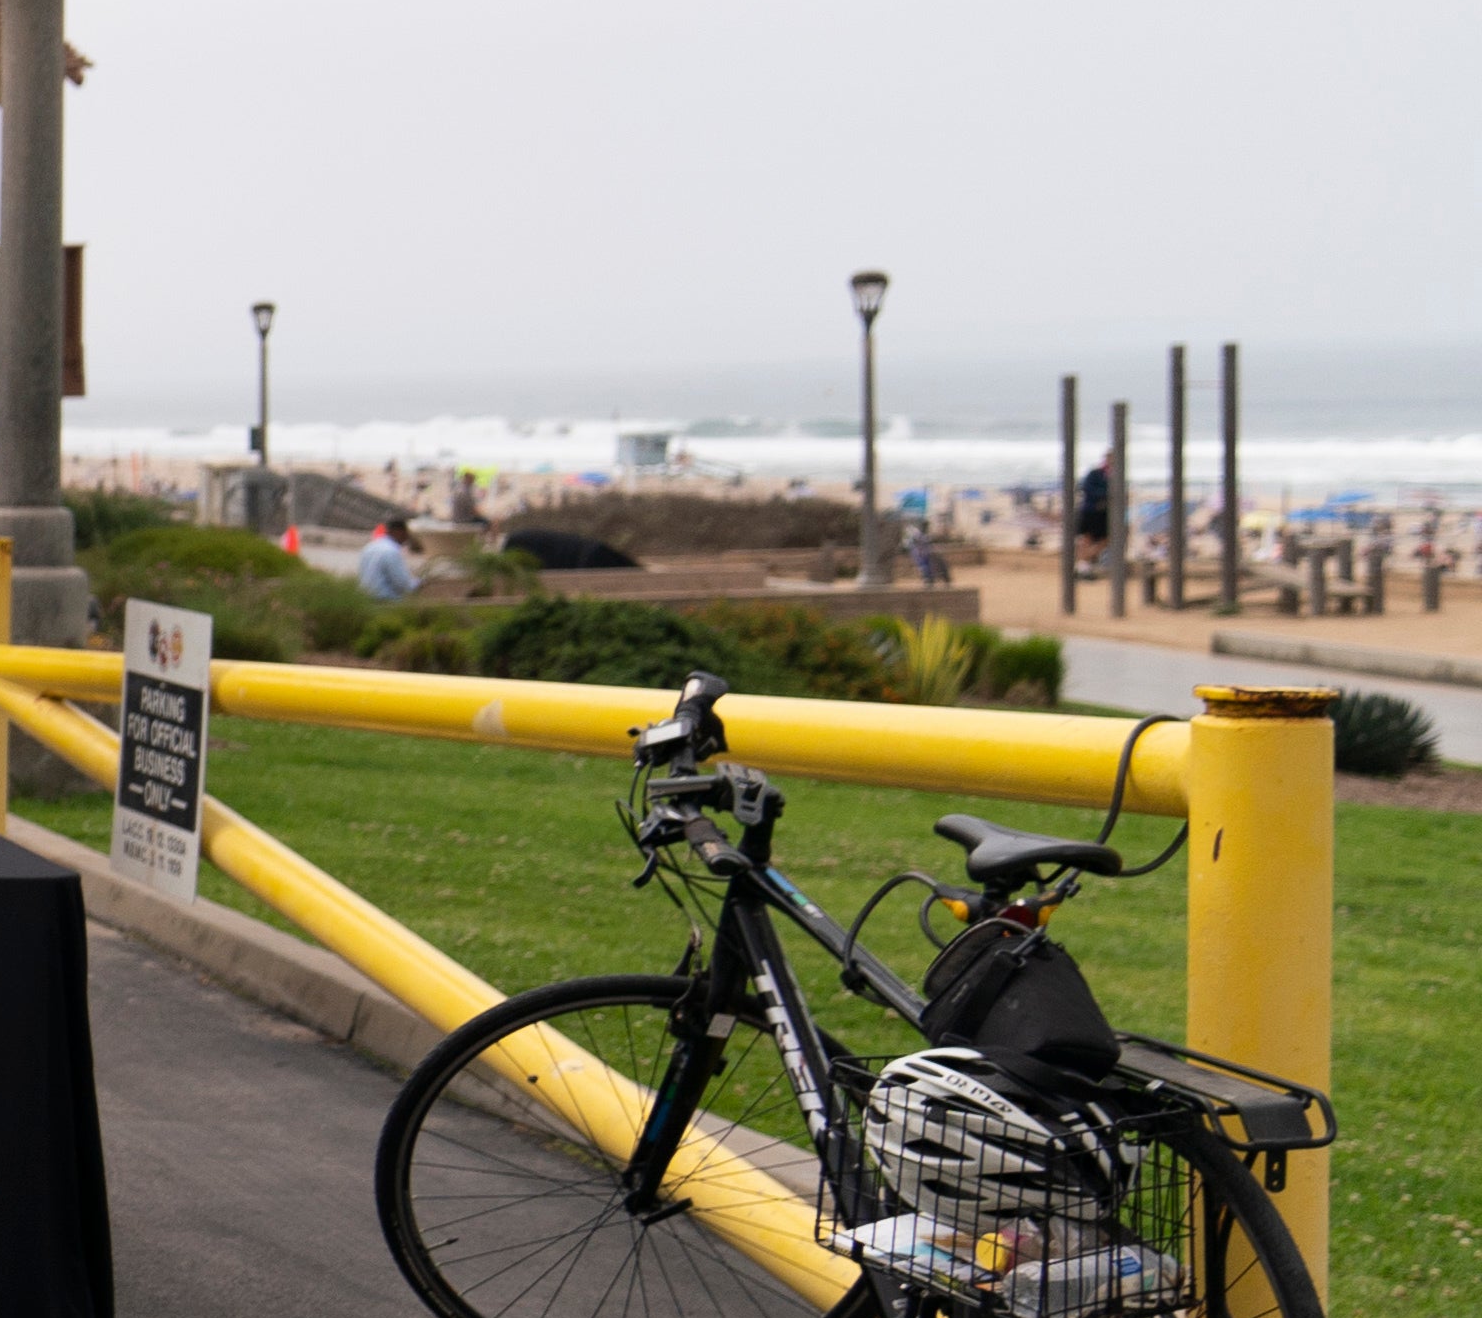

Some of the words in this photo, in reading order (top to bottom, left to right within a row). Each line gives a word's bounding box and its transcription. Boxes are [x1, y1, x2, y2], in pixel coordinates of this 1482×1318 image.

[140, 686, 186, 722] PARKING
[127, 712, 149, 745] FOR
[150, 718, 196, 759] OFFICIAL
[134, 746, 186, 786] BUSINESS
[143, 781, 172, 813] ONLY
[755, 959, 828, 1131] TREK
